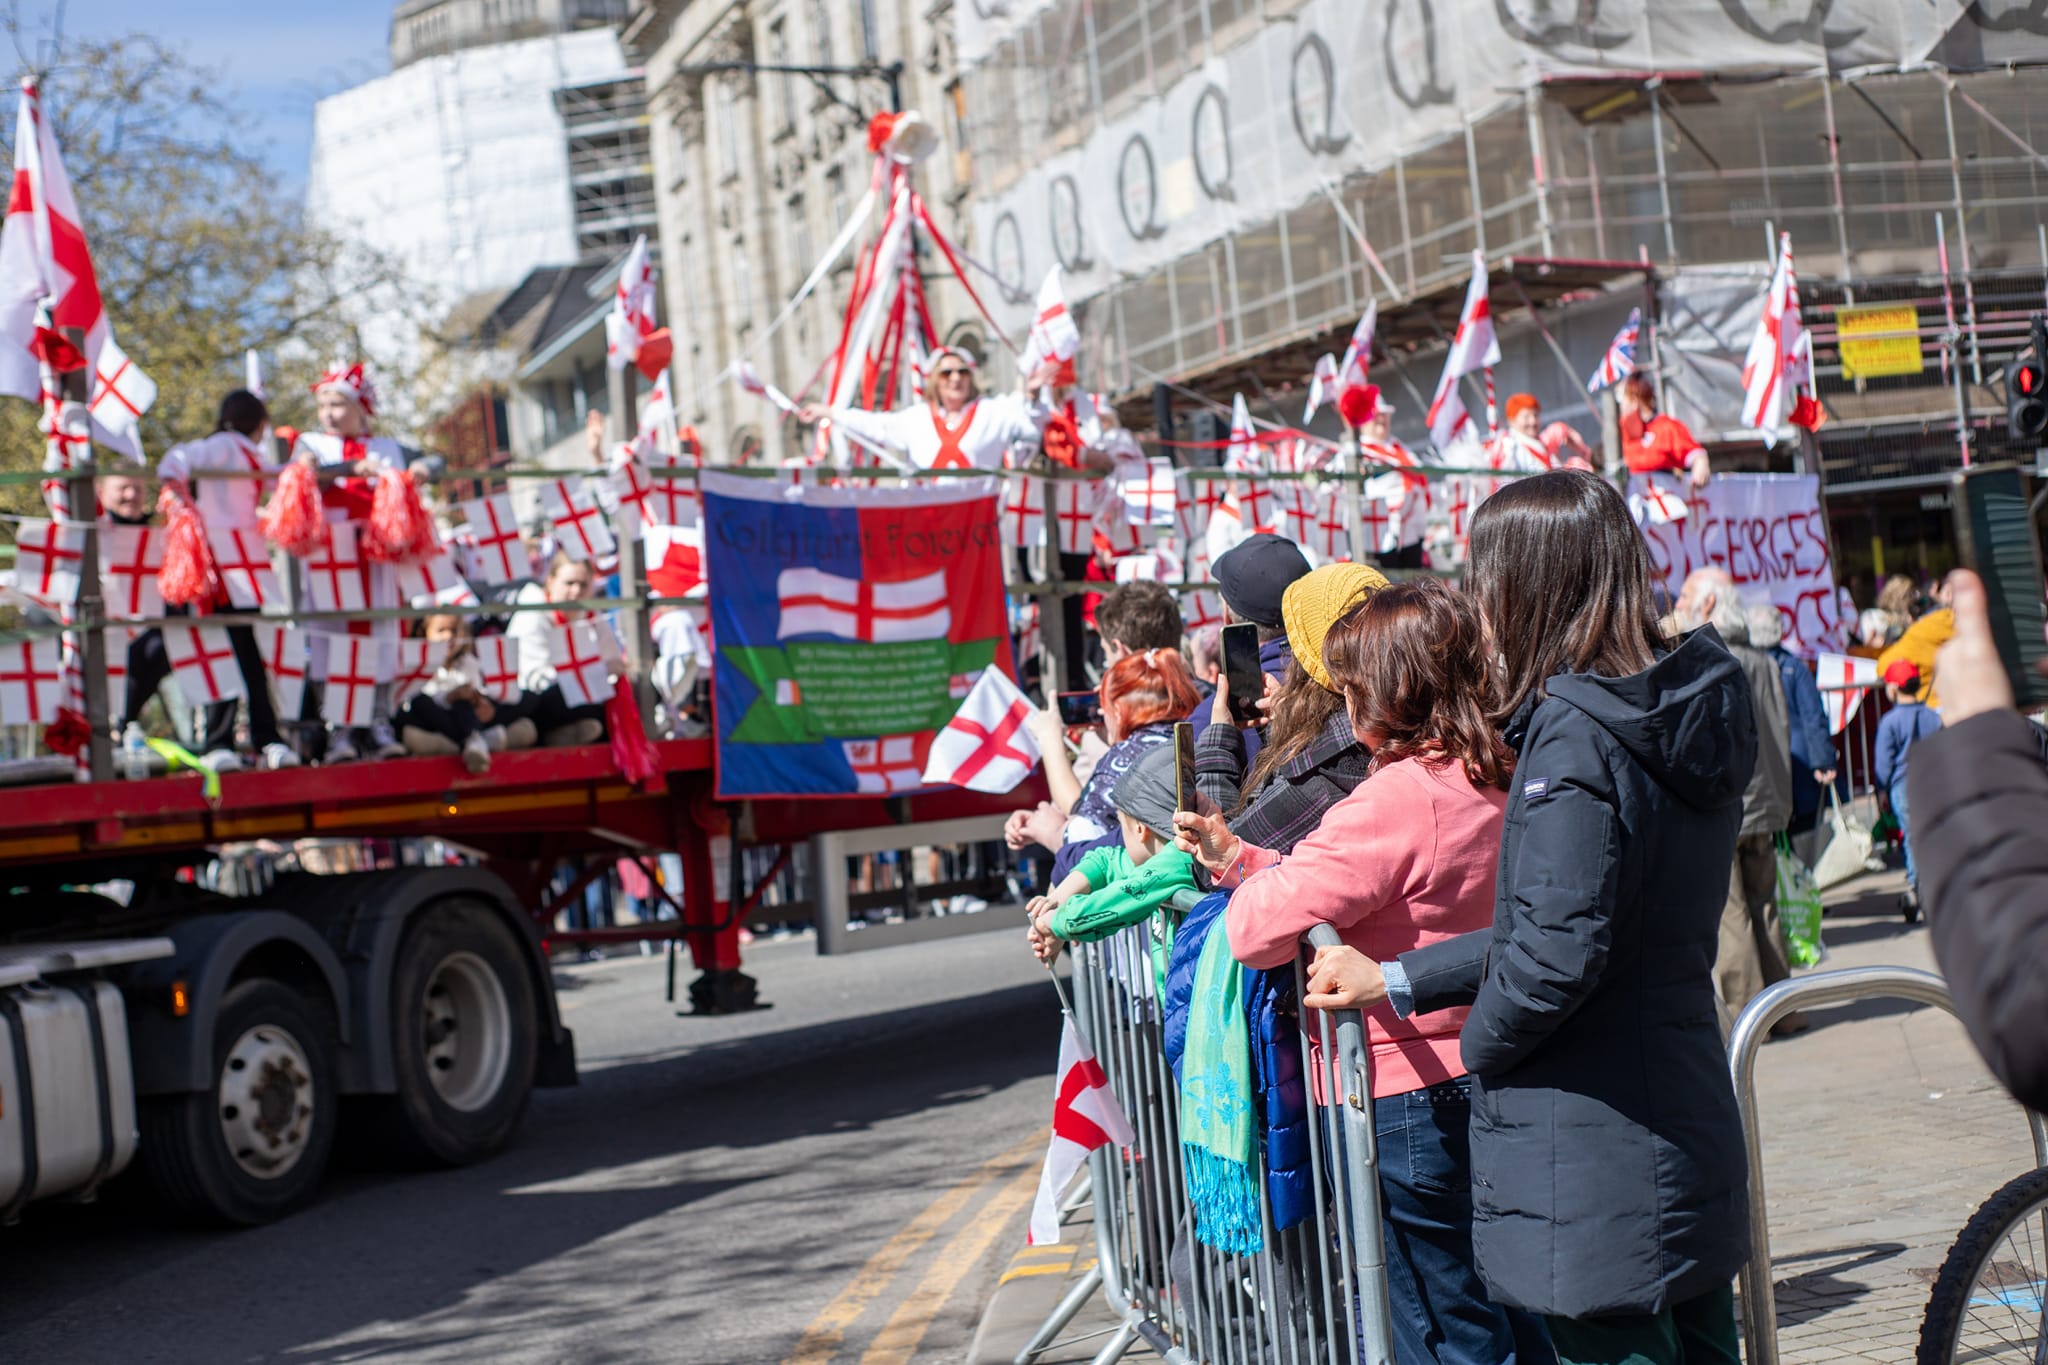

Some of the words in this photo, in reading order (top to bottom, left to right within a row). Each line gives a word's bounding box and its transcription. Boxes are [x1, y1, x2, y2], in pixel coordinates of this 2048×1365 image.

[1118, 133, 1168, 242] Q
[1290, 31, 1353, 156] Q
[1701, 509, 1831, 585] GEORGES
